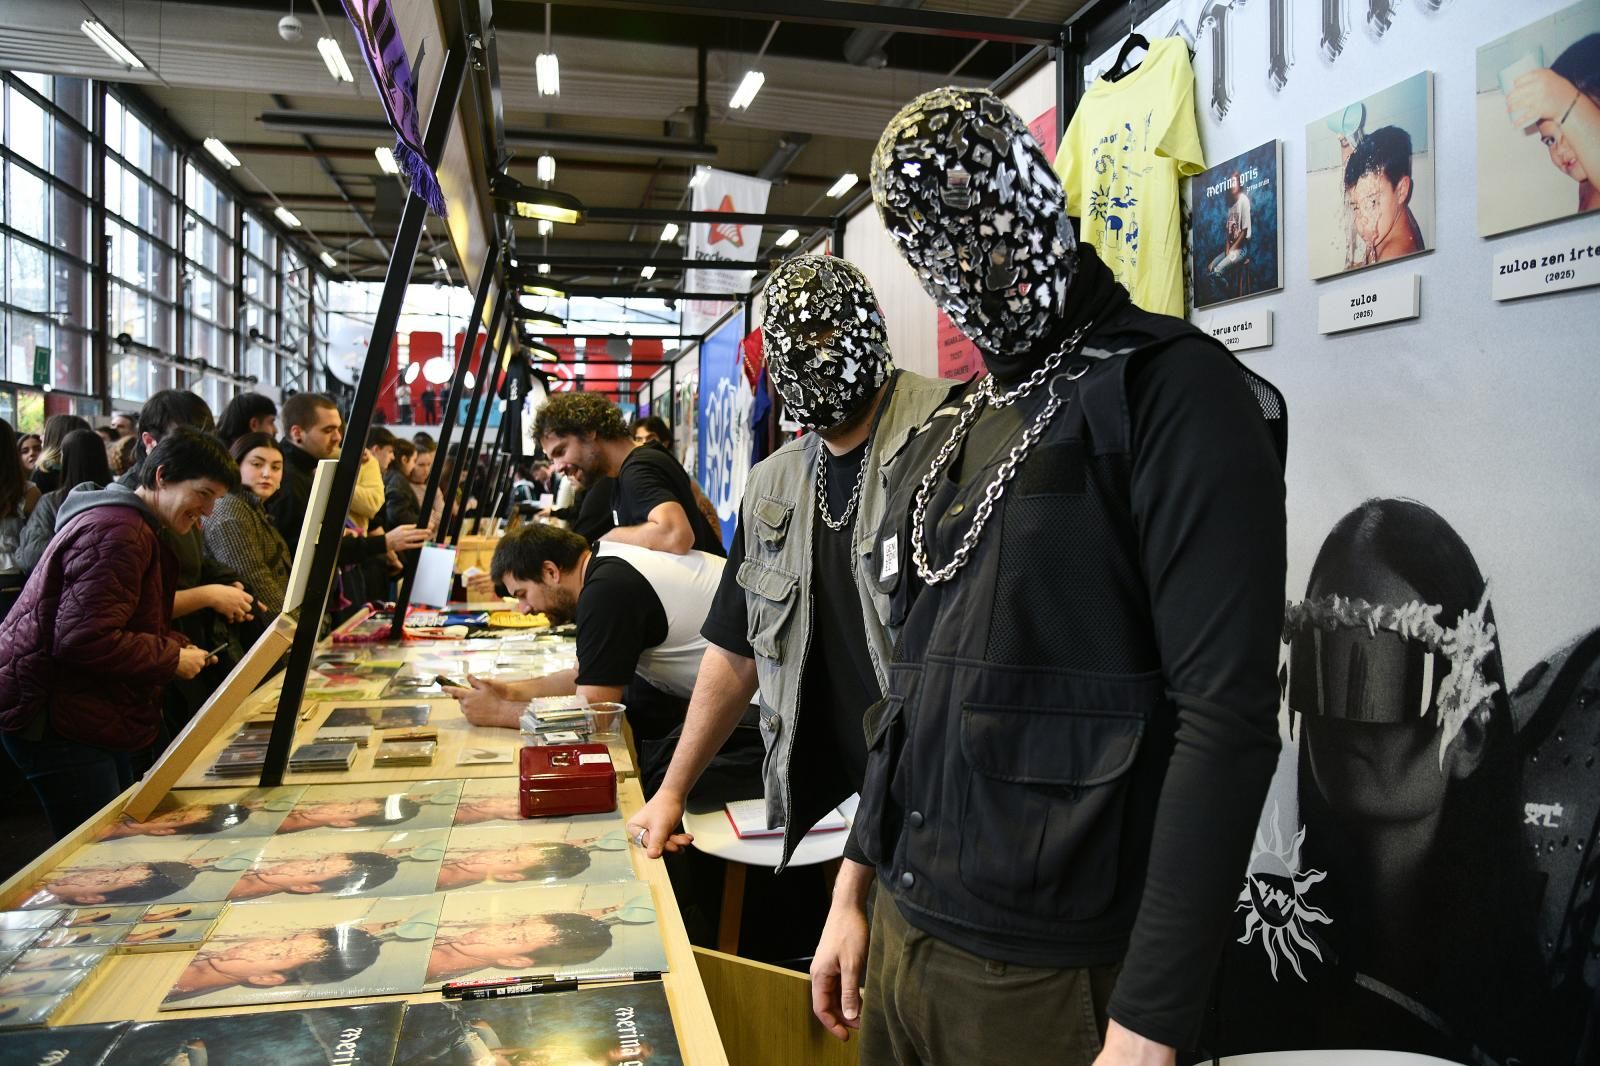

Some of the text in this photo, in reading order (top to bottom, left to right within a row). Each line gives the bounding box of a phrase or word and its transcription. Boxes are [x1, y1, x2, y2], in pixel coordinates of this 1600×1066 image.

[1206, 166, 1259, 198] merina gris
[1499, 259, 1537, 275] zuloa
[1541, 252, 1565, 267] zen
[1545, 269, 1576, 284] (2025)
[1350, 293, 1378, 307] zuloa
[1212, 321, 1253, 336] zerua orain
[615, 1006, 645, 1056] merina
